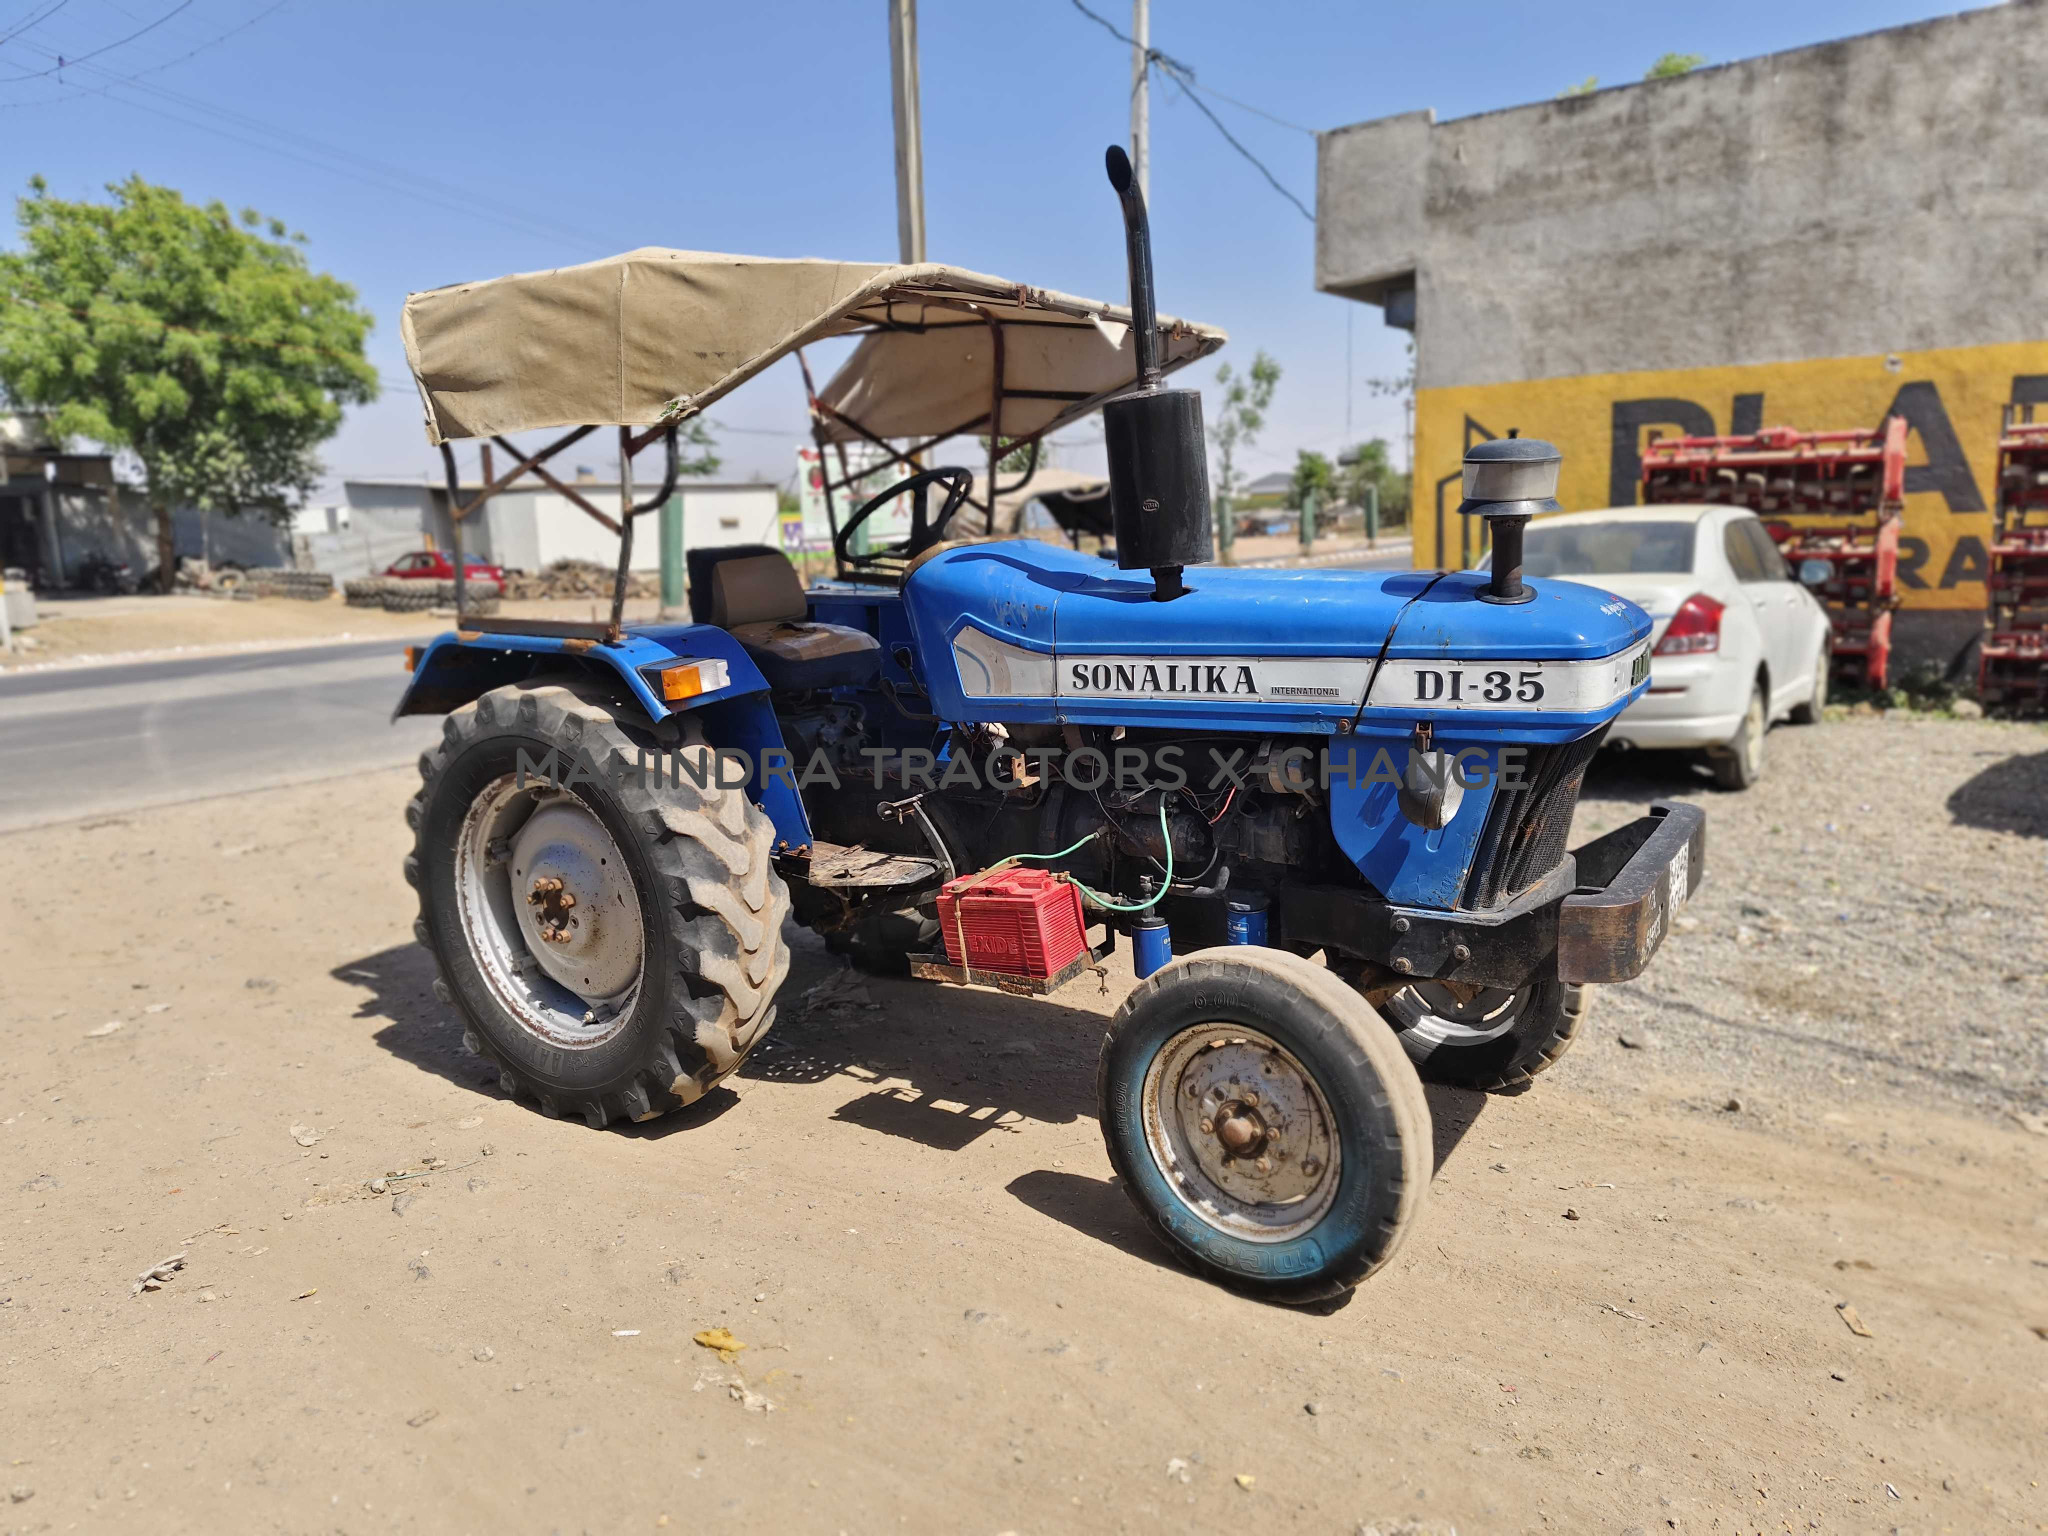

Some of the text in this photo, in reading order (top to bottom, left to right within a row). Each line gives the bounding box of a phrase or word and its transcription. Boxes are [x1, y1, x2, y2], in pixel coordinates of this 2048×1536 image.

[1072, 663, 1340, 696] SONALIKA INTERNATIONAL
[1413, 670, 1545, 702] DI-35
[968, 935, 1019, 955] EXIDE
[1115, 1081, 1129, 1136] NYLON
